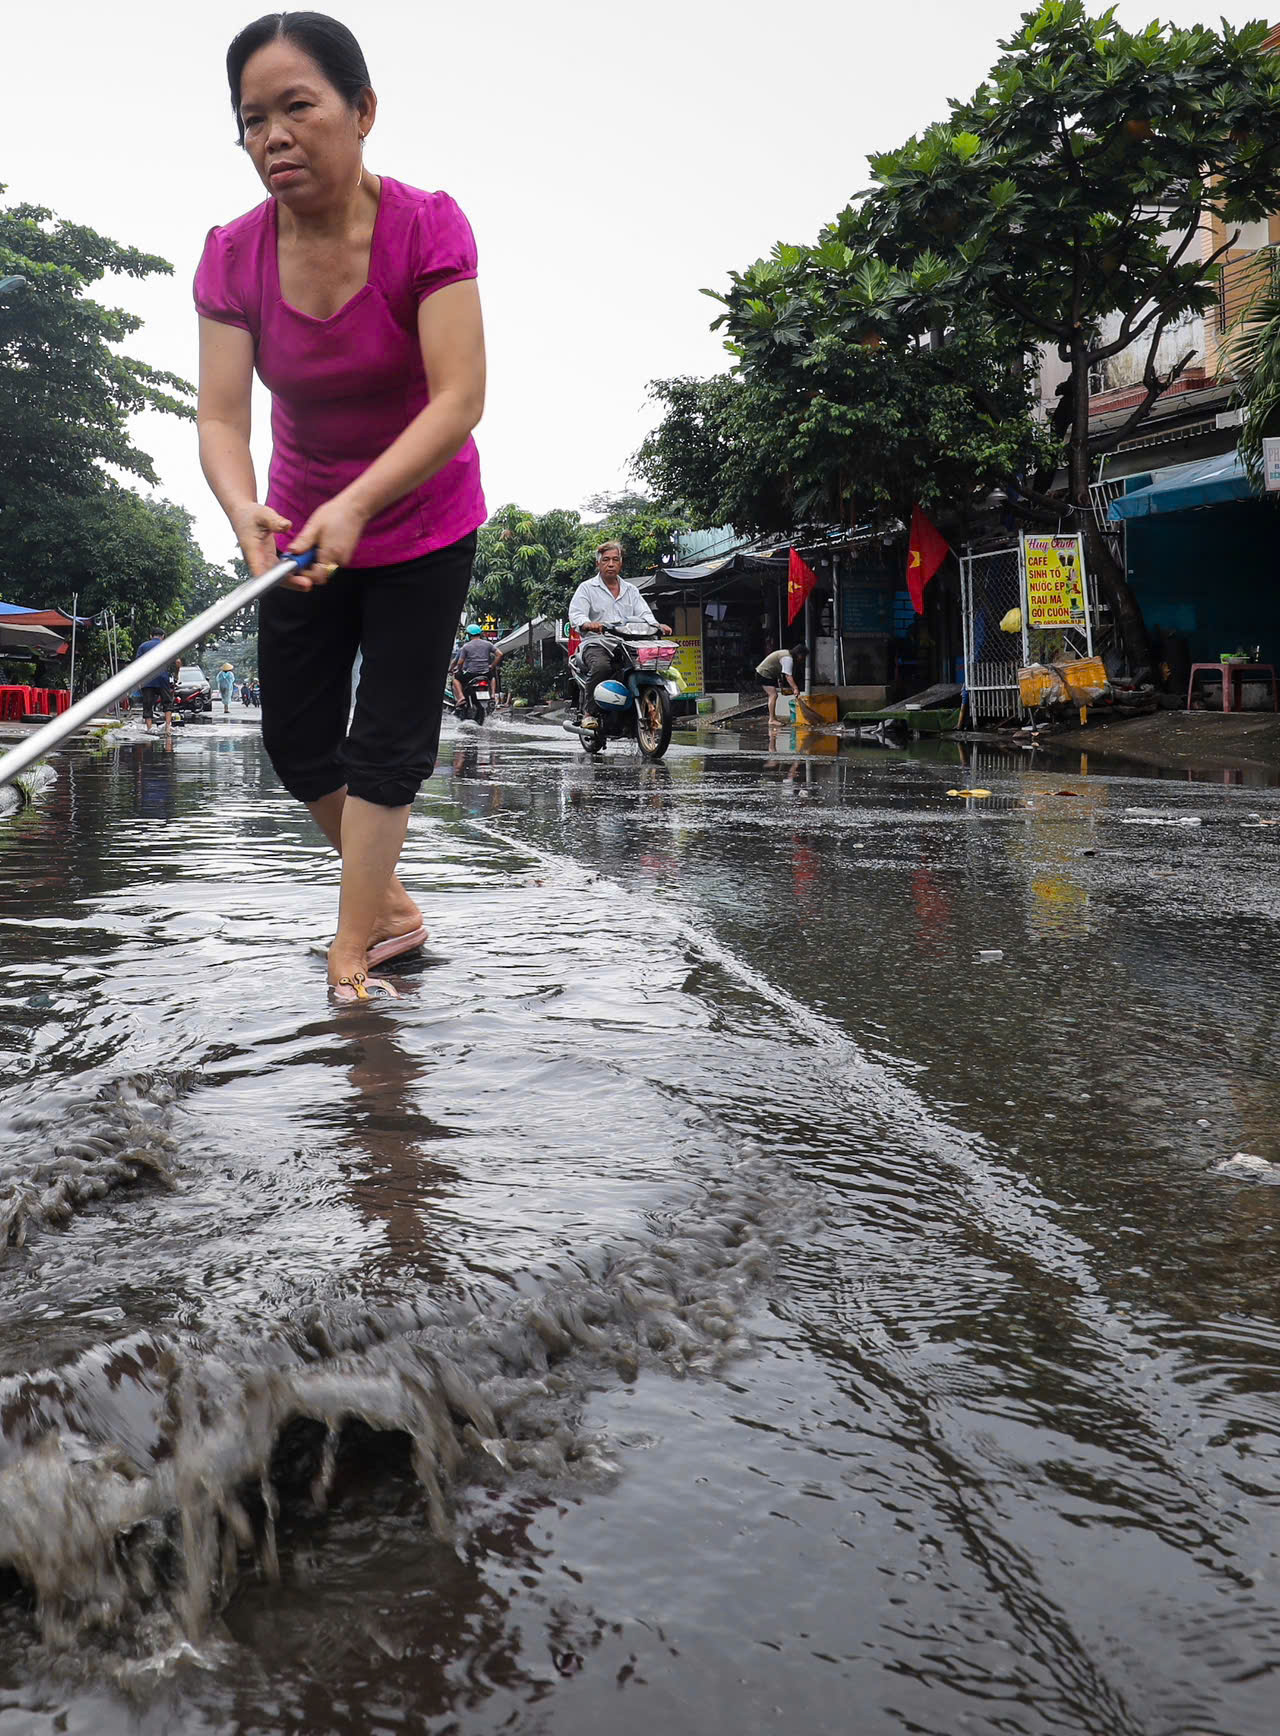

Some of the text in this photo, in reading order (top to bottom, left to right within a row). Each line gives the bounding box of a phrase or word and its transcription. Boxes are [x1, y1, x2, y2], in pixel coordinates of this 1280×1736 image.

[1028, 538, 1049, 552] Huy
[1028, 565, 1061, 579] SINH TỐ
[1029, 579, 1065, 592] NƯỚC ÉP
[1031, 592, 1062, 605] RAU MÁ
[1031, 603, 1069, 618] GỎI CUỐN
[682, 640, 701, 648] COFFEE
